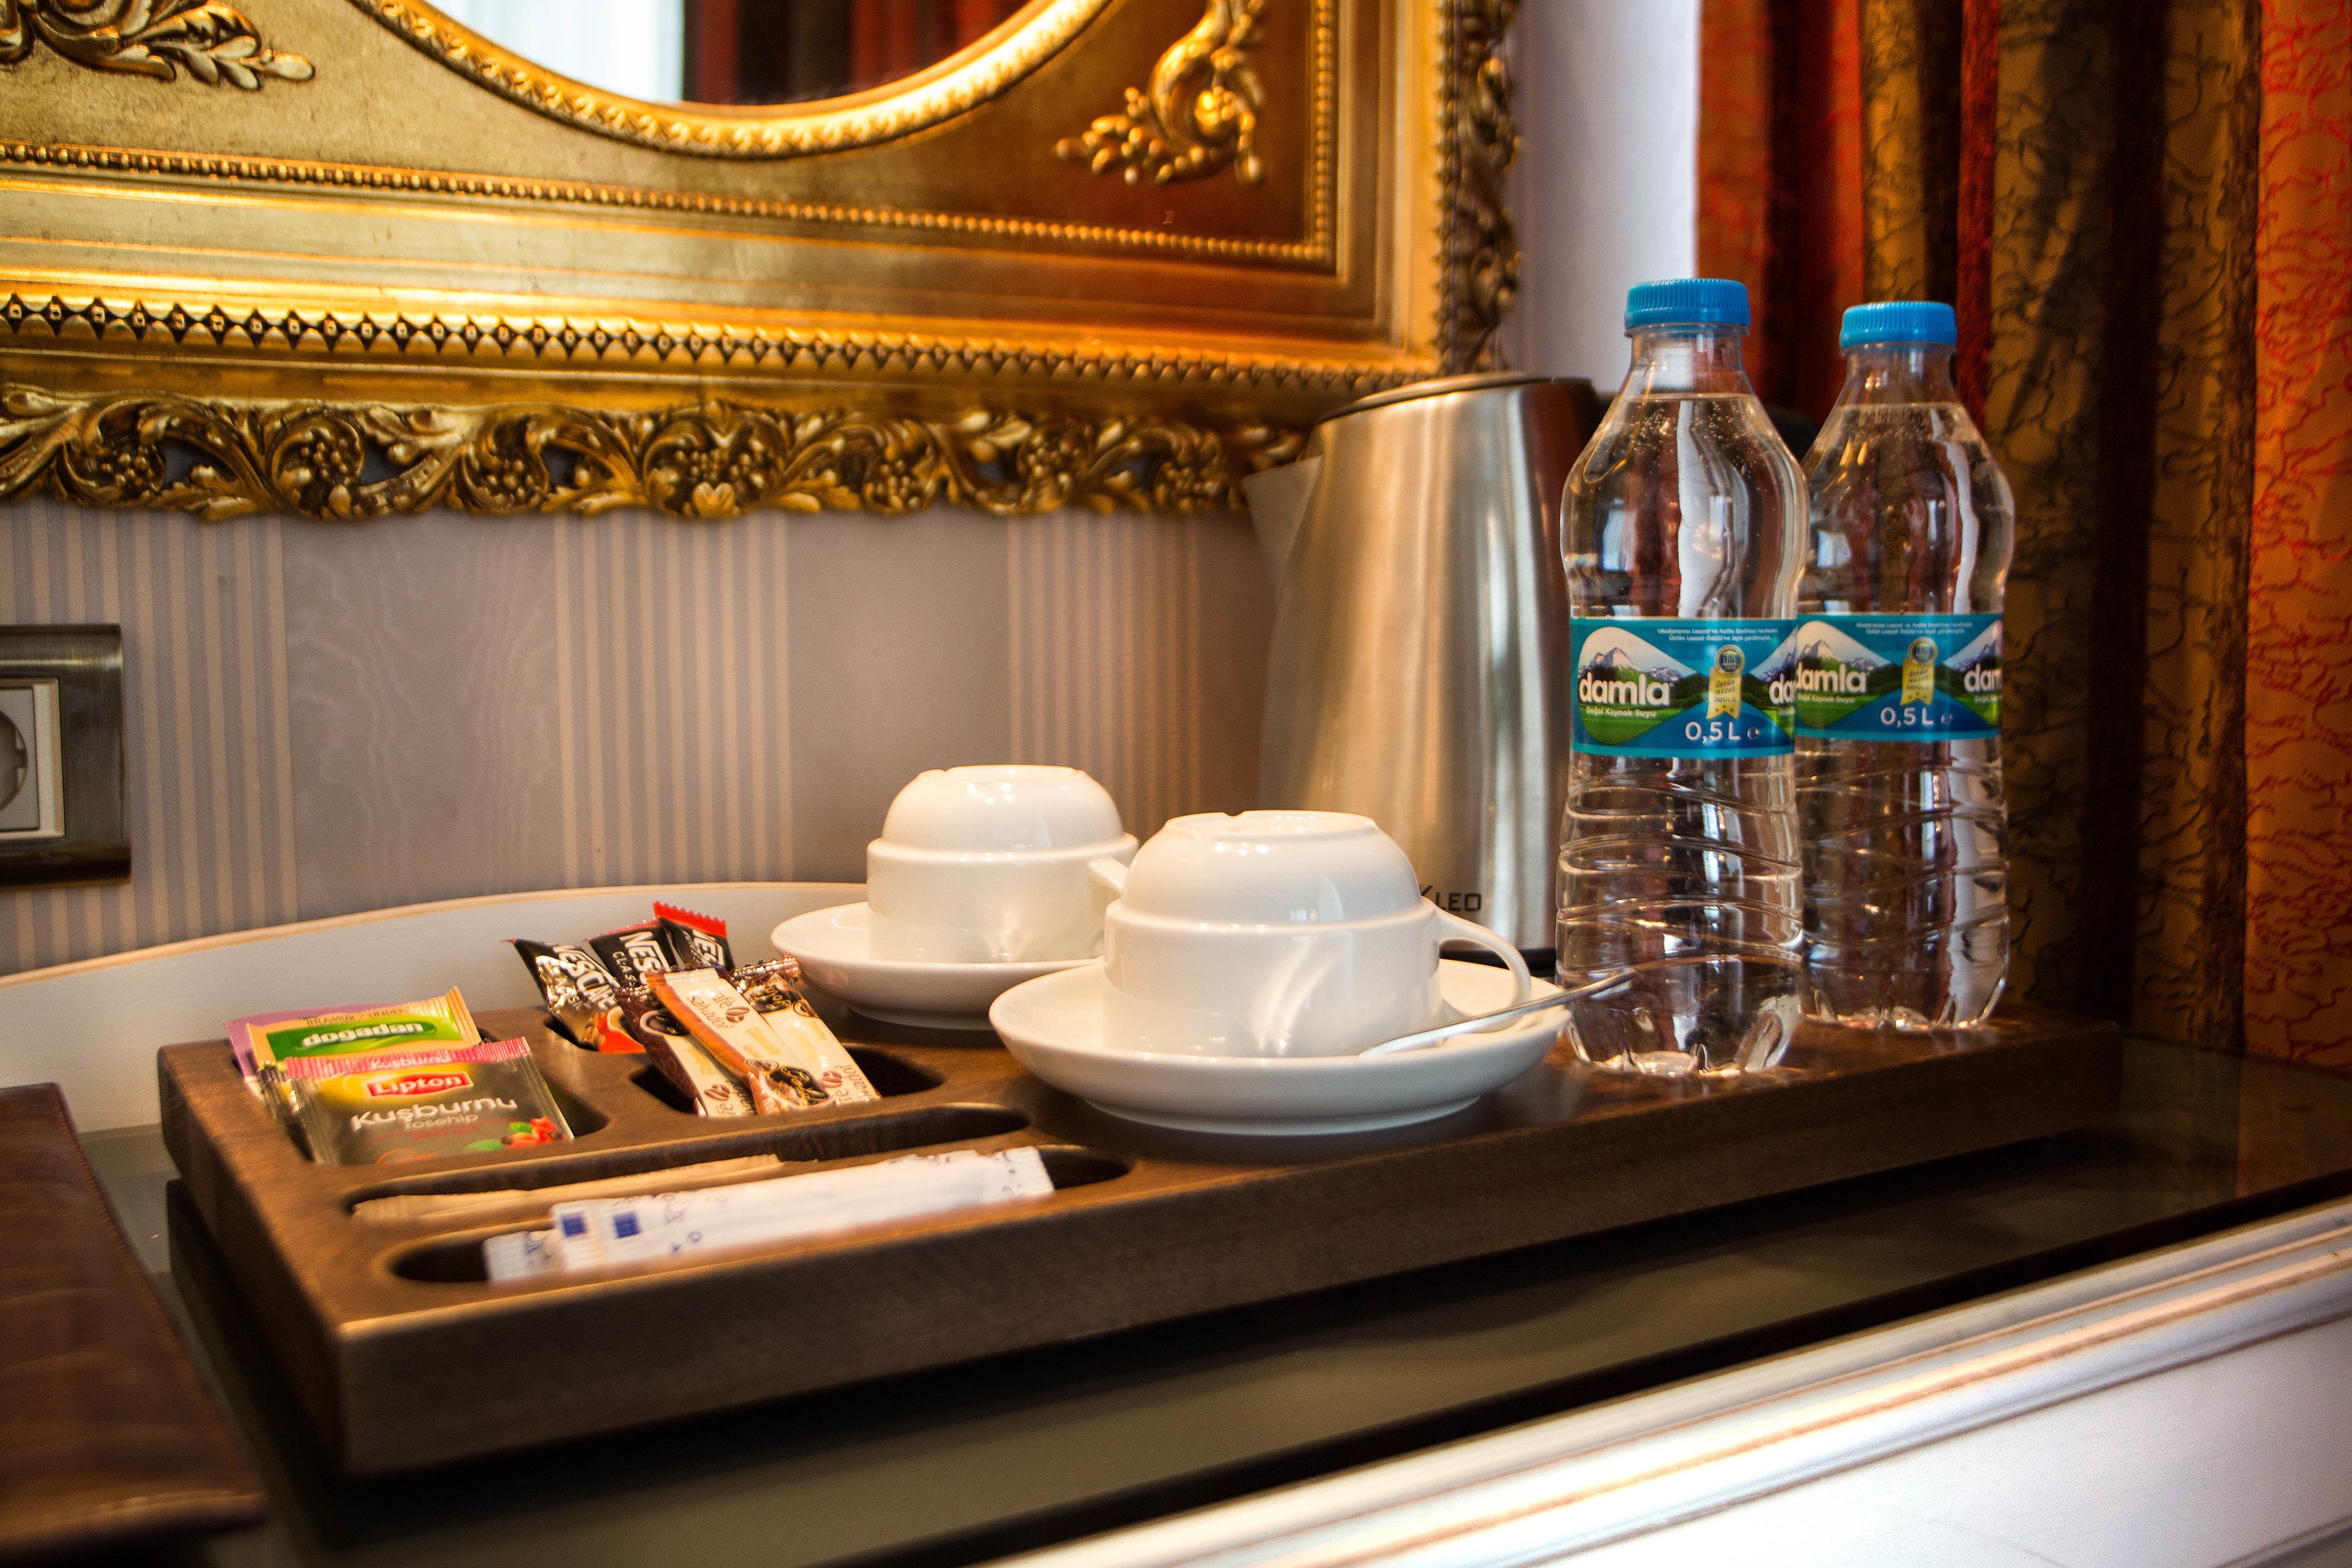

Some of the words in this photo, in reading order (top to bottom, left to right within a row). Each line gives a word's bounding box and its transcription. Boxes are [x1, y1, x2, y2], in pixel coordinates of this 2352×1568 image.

[1578, 671, 1670, 705] damla
[1880, 706, 1916, 728] 0,5
[1921, 707, 1934, 725] L
[1684, 721, 1724, 744] 0,5
[1728, 721, 1740, 741] L
[374, 1076, 463, 1095] Lipton
[350, 1096, 518, 1132] Kuşburnu
[404, 1113, 479, 1130] rosehip
